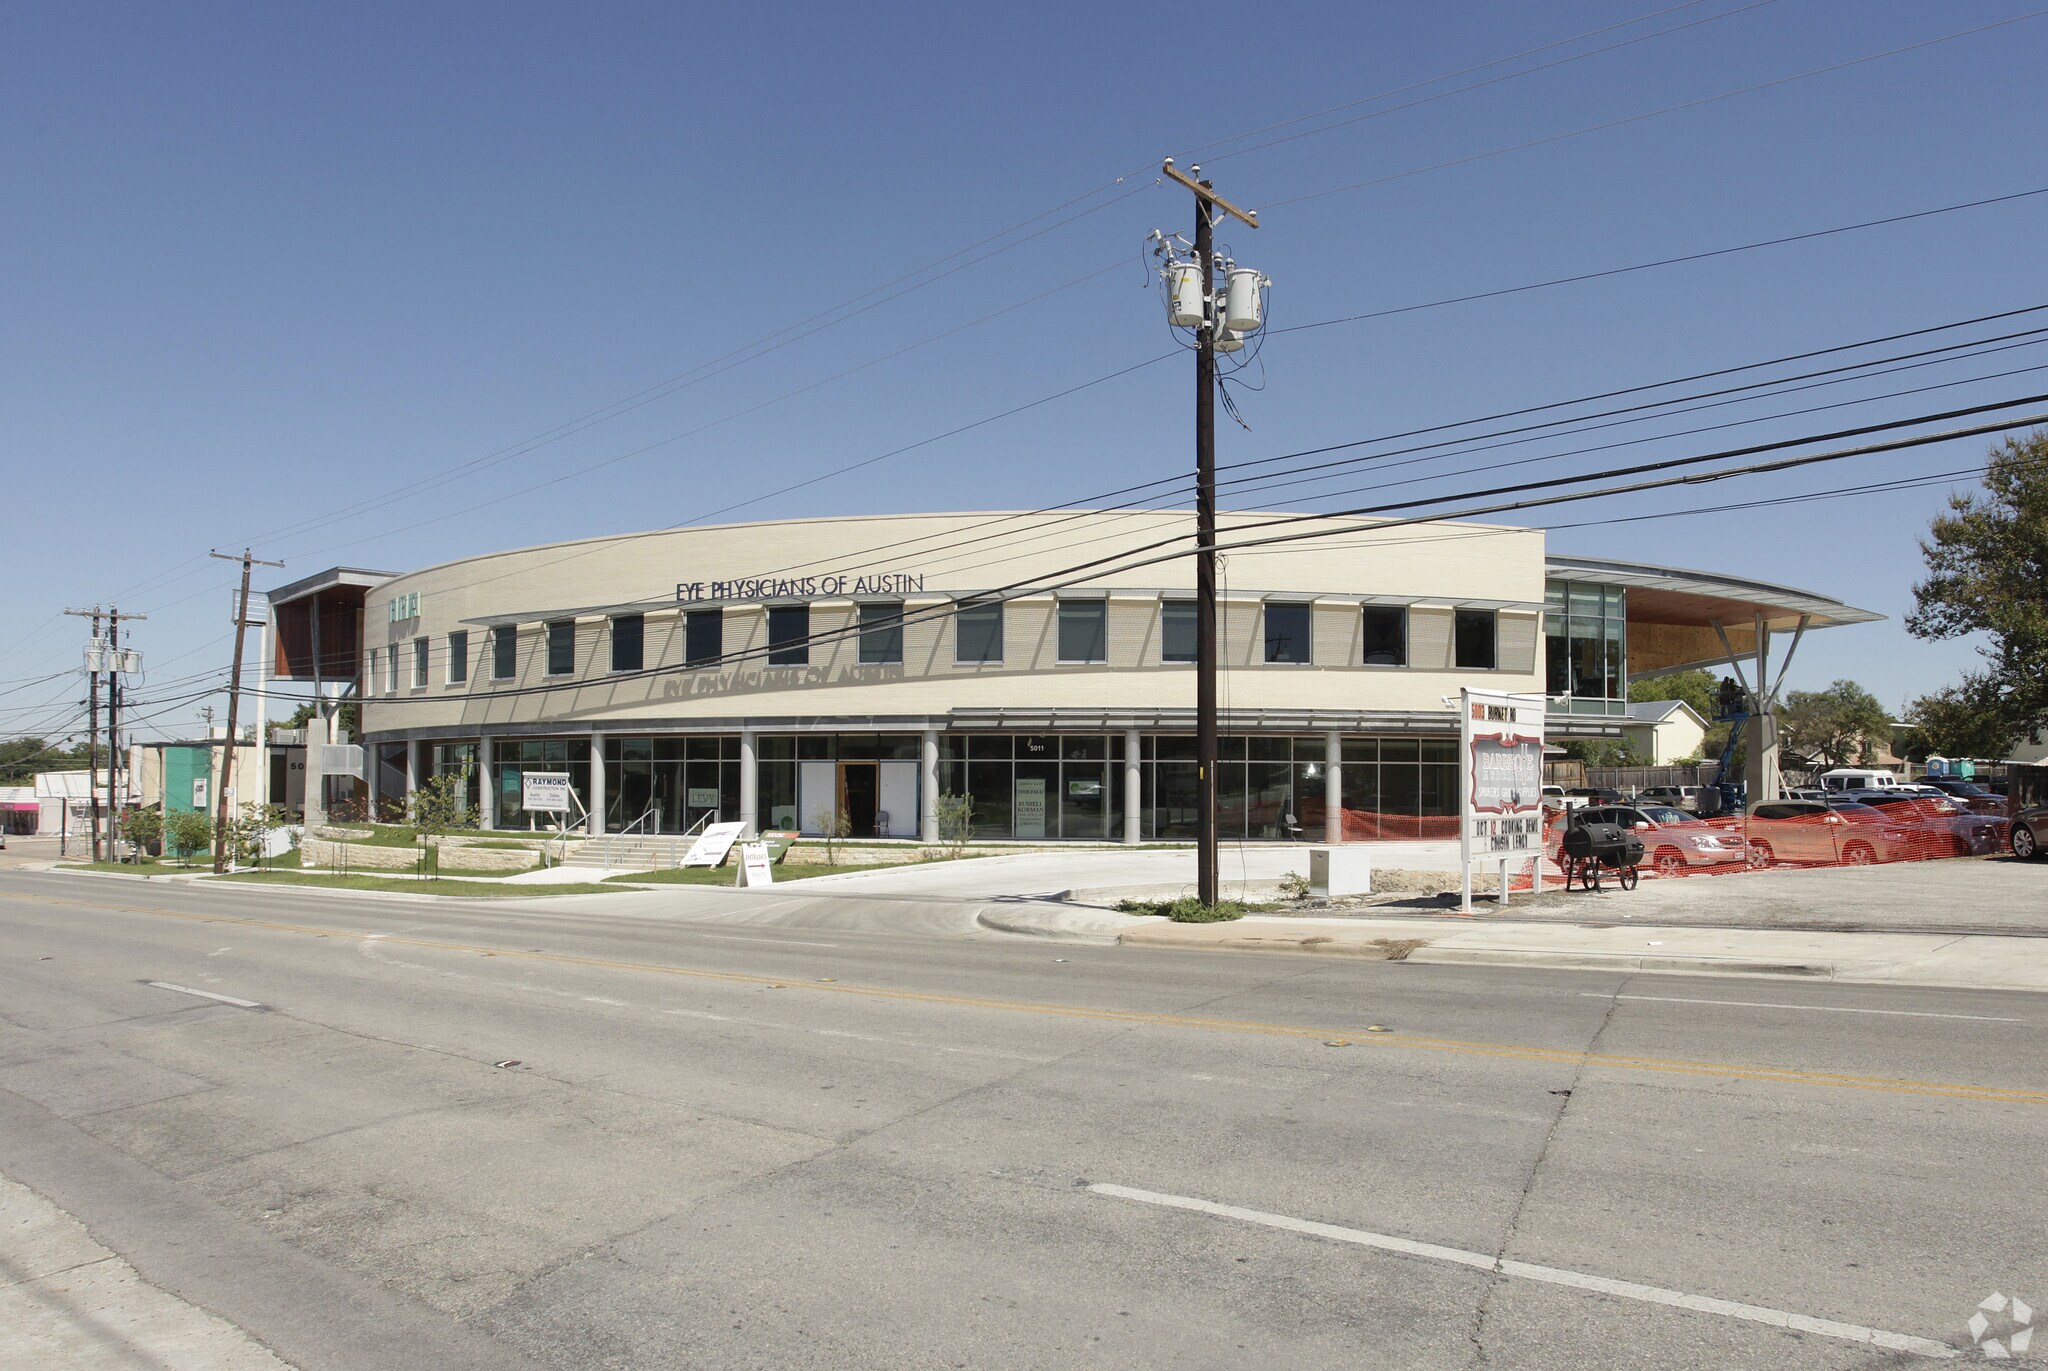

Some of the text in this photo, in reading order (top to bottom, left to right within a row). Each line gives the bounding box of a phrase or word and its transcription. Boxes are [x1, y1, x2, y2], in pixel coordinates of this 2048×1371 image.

[676, 573, 924, 600] EYE PHYSICIANS OF AUSTIN
[1472, 703, 1517, 722] 5003 BURNET RD
[1482, 745, 1534, 771] BARBEQUE
[532, 778, 567, 786] RAYMOND
[692, 793, 715, 803] LEVY
[1478, 787, 1500, 798] SMOKERS
[1476, 818, 1538, 836] OCT 12 COOKING DEMO
[1490, 835, 1528, 851] COUSIN LEROY
[745, 853, 767, 861] ENTRANCE
